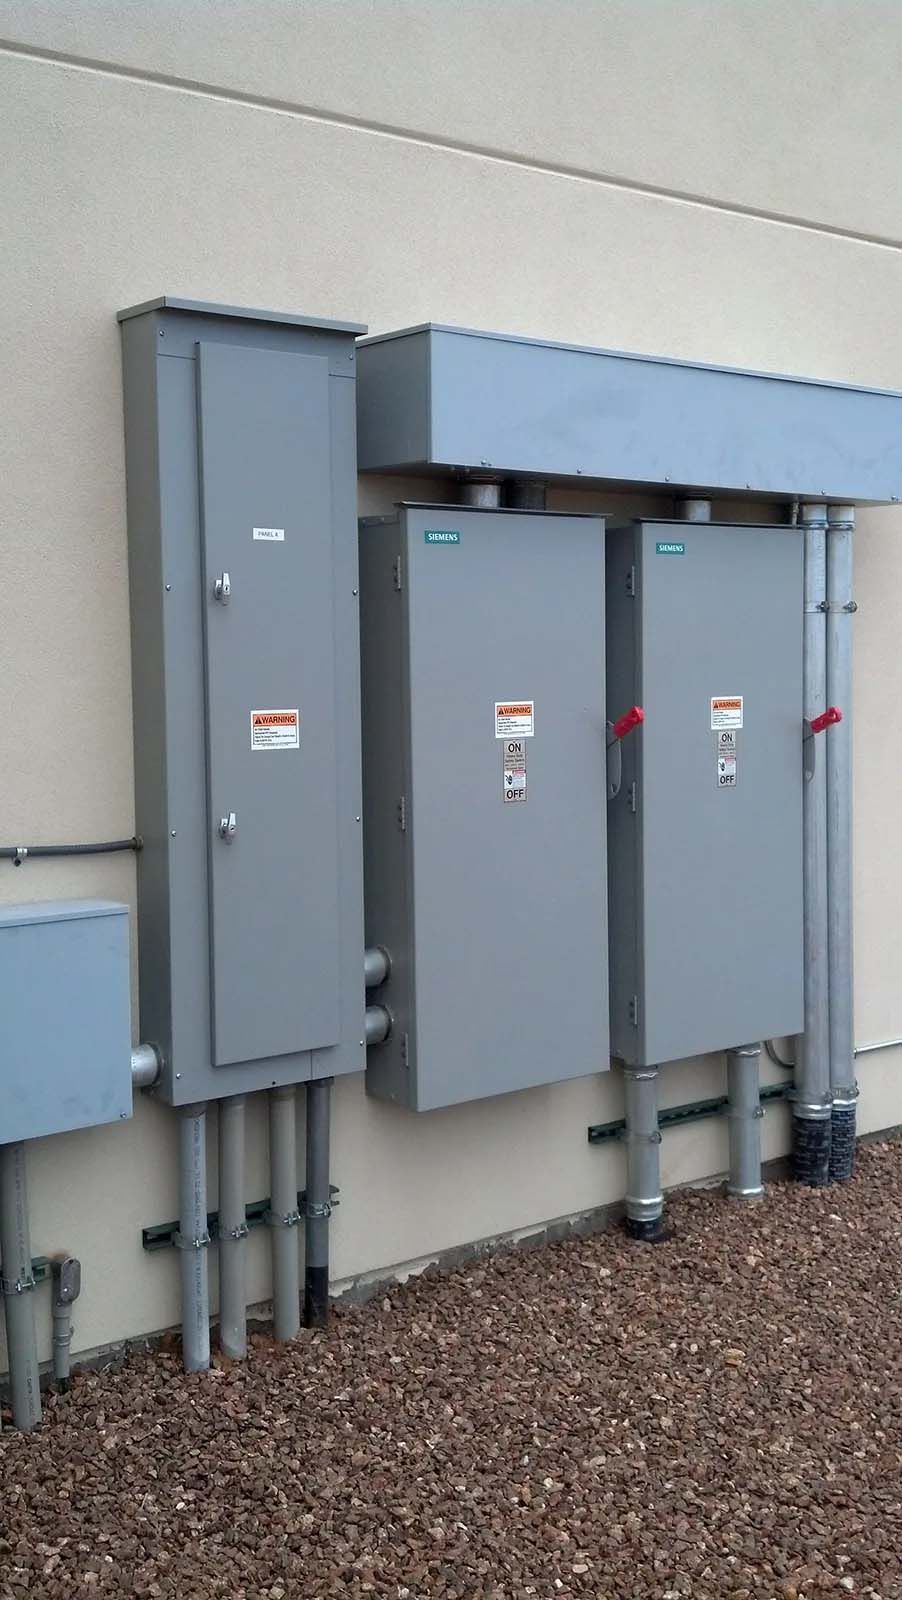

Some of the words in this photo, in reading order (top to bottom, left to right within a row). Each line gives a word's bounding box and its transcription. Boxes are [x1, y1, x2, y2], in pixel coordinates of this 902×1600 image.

[428, 533, 458, 541] SIEMENS
[659, 544, 684, 552] SIEMENS
[503, 706, 531, 715] WARNING
[261, 715, 296, 724] WARNING
[721, 733, 733, 742] ON
[508, 743, 521, 753] ON
[719, 775, 735, 784] OFF
[506, 789, 524, 800] OFF
